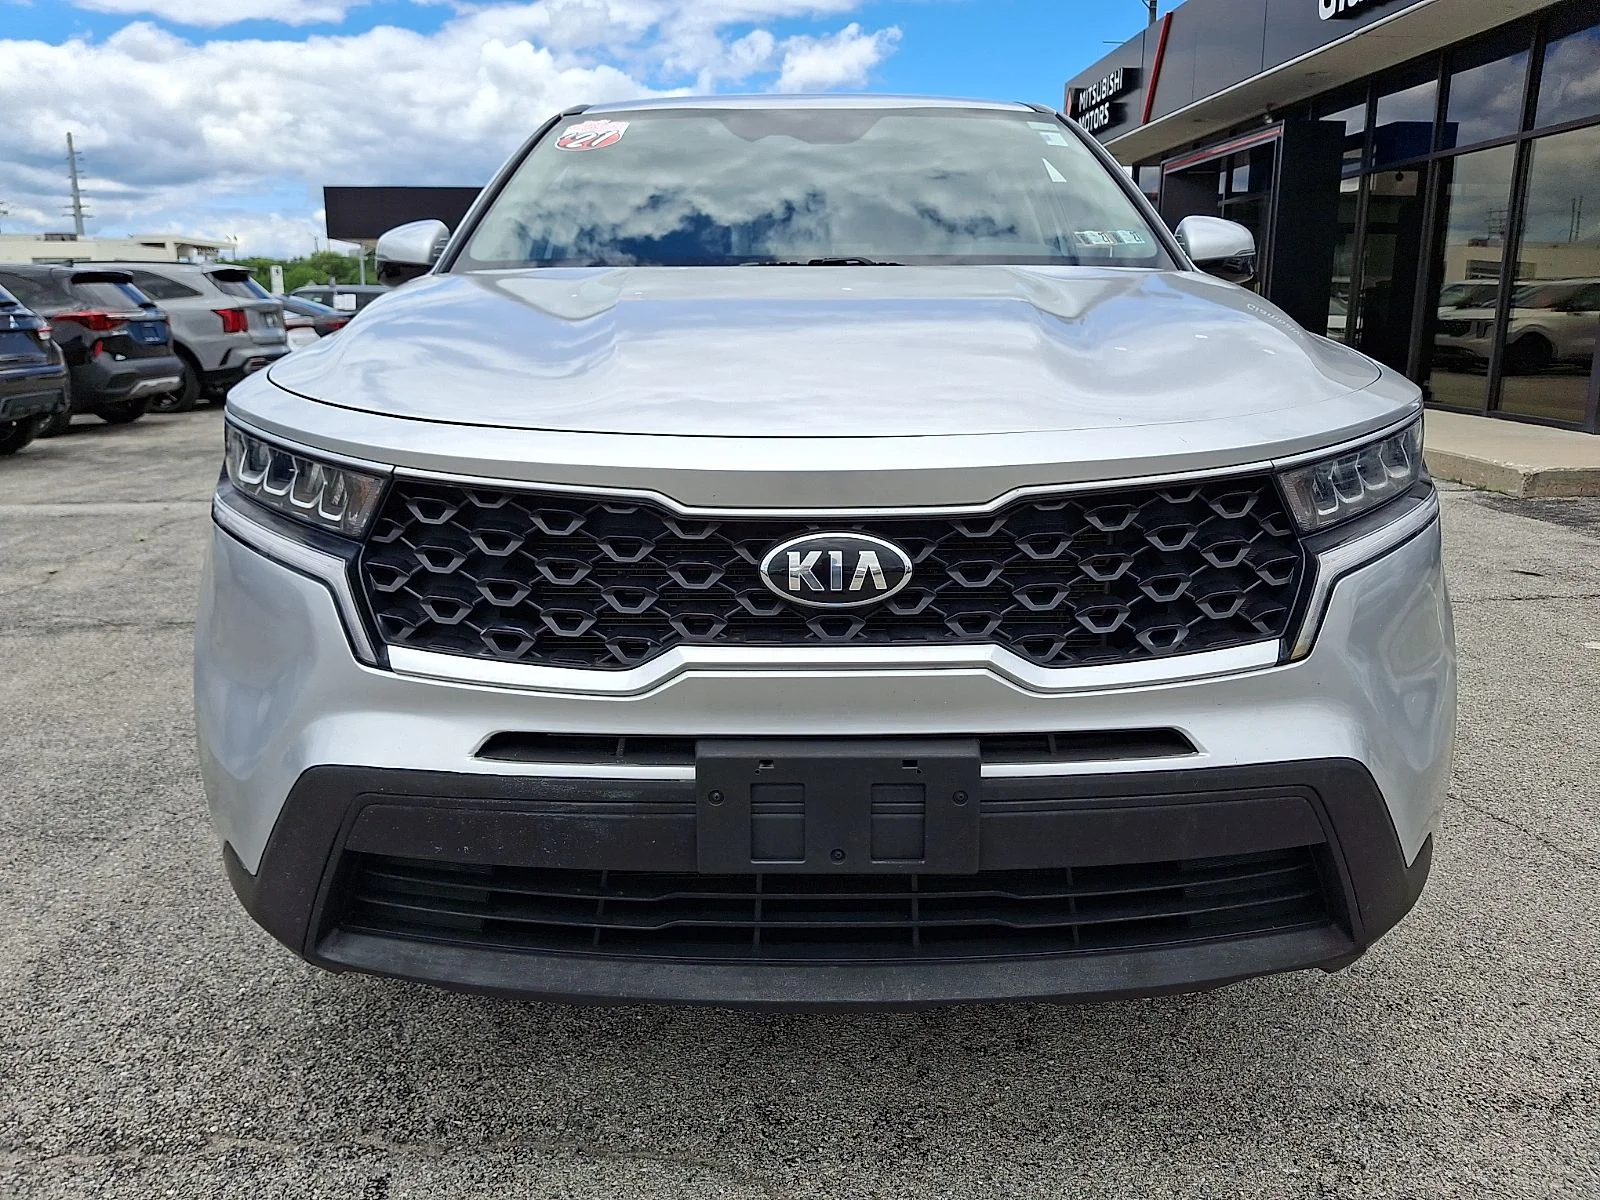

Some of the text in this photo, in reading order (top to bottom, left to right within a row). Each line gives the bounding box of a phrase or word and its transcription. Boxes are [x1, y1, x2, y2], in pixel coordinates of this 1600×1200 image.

[1078, 67, 1123, 113] MITSUBISHI
[1078, 101, 1110, 133] MOTORS
[786, 550, 888, 592] KIA
